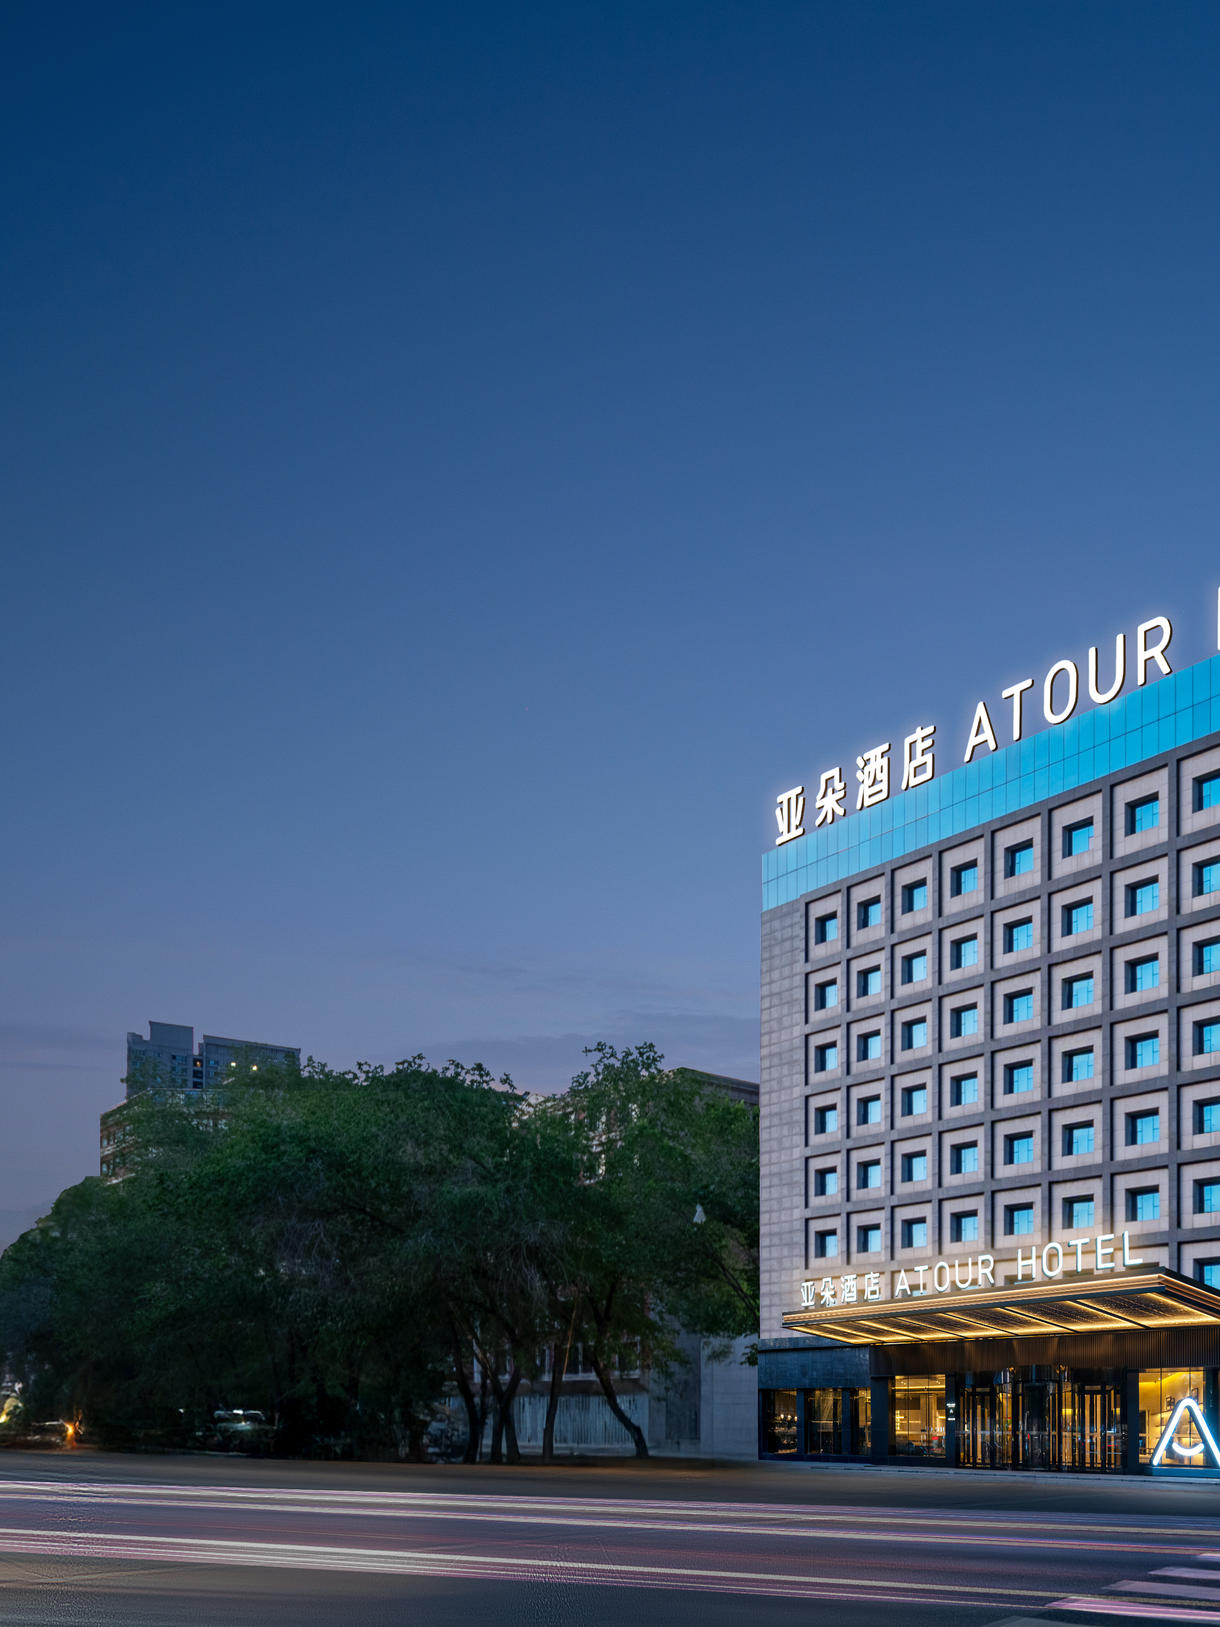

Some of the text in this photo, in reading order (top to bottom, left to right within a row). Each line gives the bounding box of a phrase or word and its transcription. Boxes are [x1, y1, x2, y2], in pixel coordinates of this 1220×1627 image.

[775, 726, 935, 845] 亚朵酒店
[964, 616, 1171, 762] ATOUR
[800, 1231, 1143, 1308] 亚朵酒店 ATOUR HOTEL
